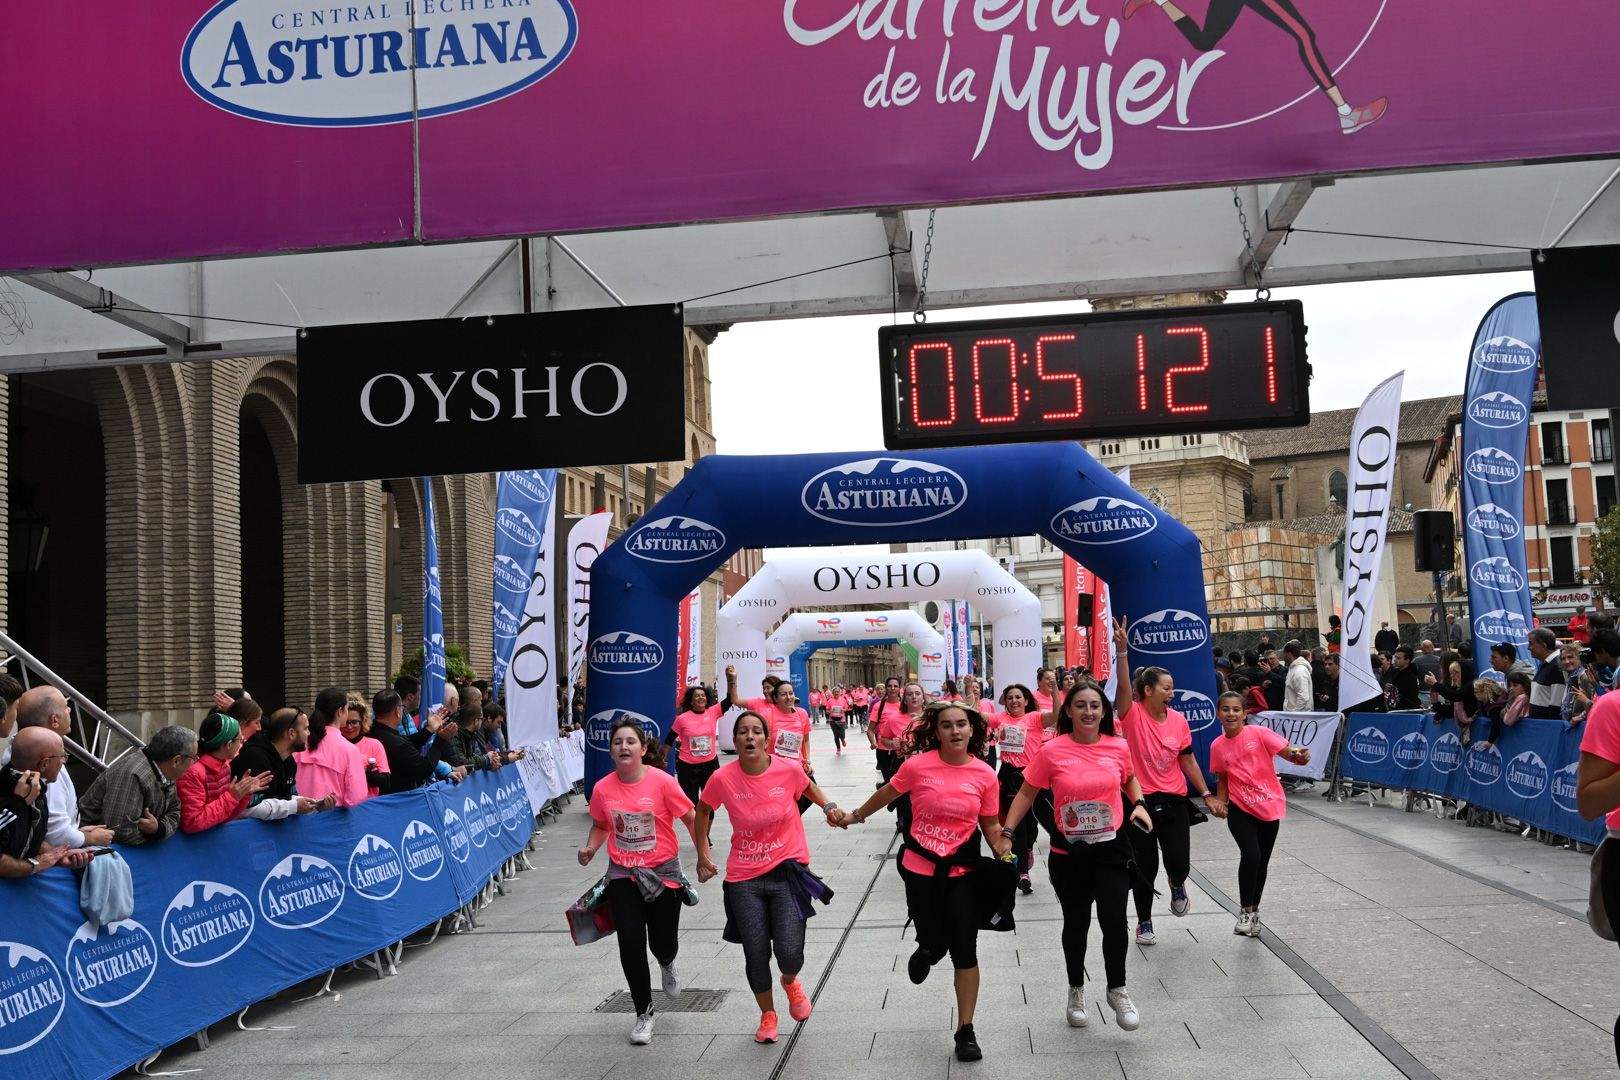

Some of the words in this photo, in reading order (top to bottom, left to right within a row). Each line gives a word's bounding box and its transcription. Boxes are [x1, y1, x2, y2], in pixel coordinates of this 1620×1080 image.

[271, 4, 391, 30] CENTRAL
[211, 16, 547, 89] ASTURIANA
[863, 46, 921, 108] de
[935, 40, 977, 104] la
[971, 18, 1226, 170] Mujer
[1480, 349, 1531, 365] ASTURIANA
[360, 362, 628, 427] OYSHO
[1472, 403, 1521, 421] ASTURIANA
[839, 478, 891, 487] CENTRAL
[896, 475, 949, 485] LECHERA
[814, 481, 956, 511] ASTURIANA
[497, 513, 536, 543] ASTURIANA
[1060, 516, 1151, 535] ASTURIANA
[1472, 513, 1515, 534] ASTUANA
[630, 533, 718, 551] ASTURIANA
[813, 561, 941, 592] OYSHO
[1475, 567, 1520, 588] ASTRIA
[977, 586, 1016, 596] OYSHO
[738, 598, 777, 609] OYSHO
[1000, 638, 1037, 649] OYSHO
[1132, 628, 1204, 645] ASTURIANA
[590, 646, 659, 663] ASTURIANA
[721, 650, 758, 660] OYSHO
[1079, 638, 1088, 667] orts
[1352, 737, 1385, 756] ASTURIANA
[1508, 763, 1544, 790] ASTURIANA
[918, 821, 960, 840] DORSAL
[741, 838, 784, 852] DORSAL
[915, 834, 946, 854] SUMA
[406, 844, 441, 870] ASTURIANA
[357, 859, 400, 888] ASTURIANA
[269, 879, 341, 918] ASTURIANA
[179, 911, 207, 926] CENTRAL
[210, 898, 241, 918] LECHERA
[171, 908, 251, 956] ASTURIANA
[82, 944, 110, 960] CENTRAL
[113, 933, 145, 951] LECHERA
[17, 964, 50, 983] LECHERA
[74, 944, 154, 992] ASTURIANA
[0, 978, 62, 1028] TURIANA
